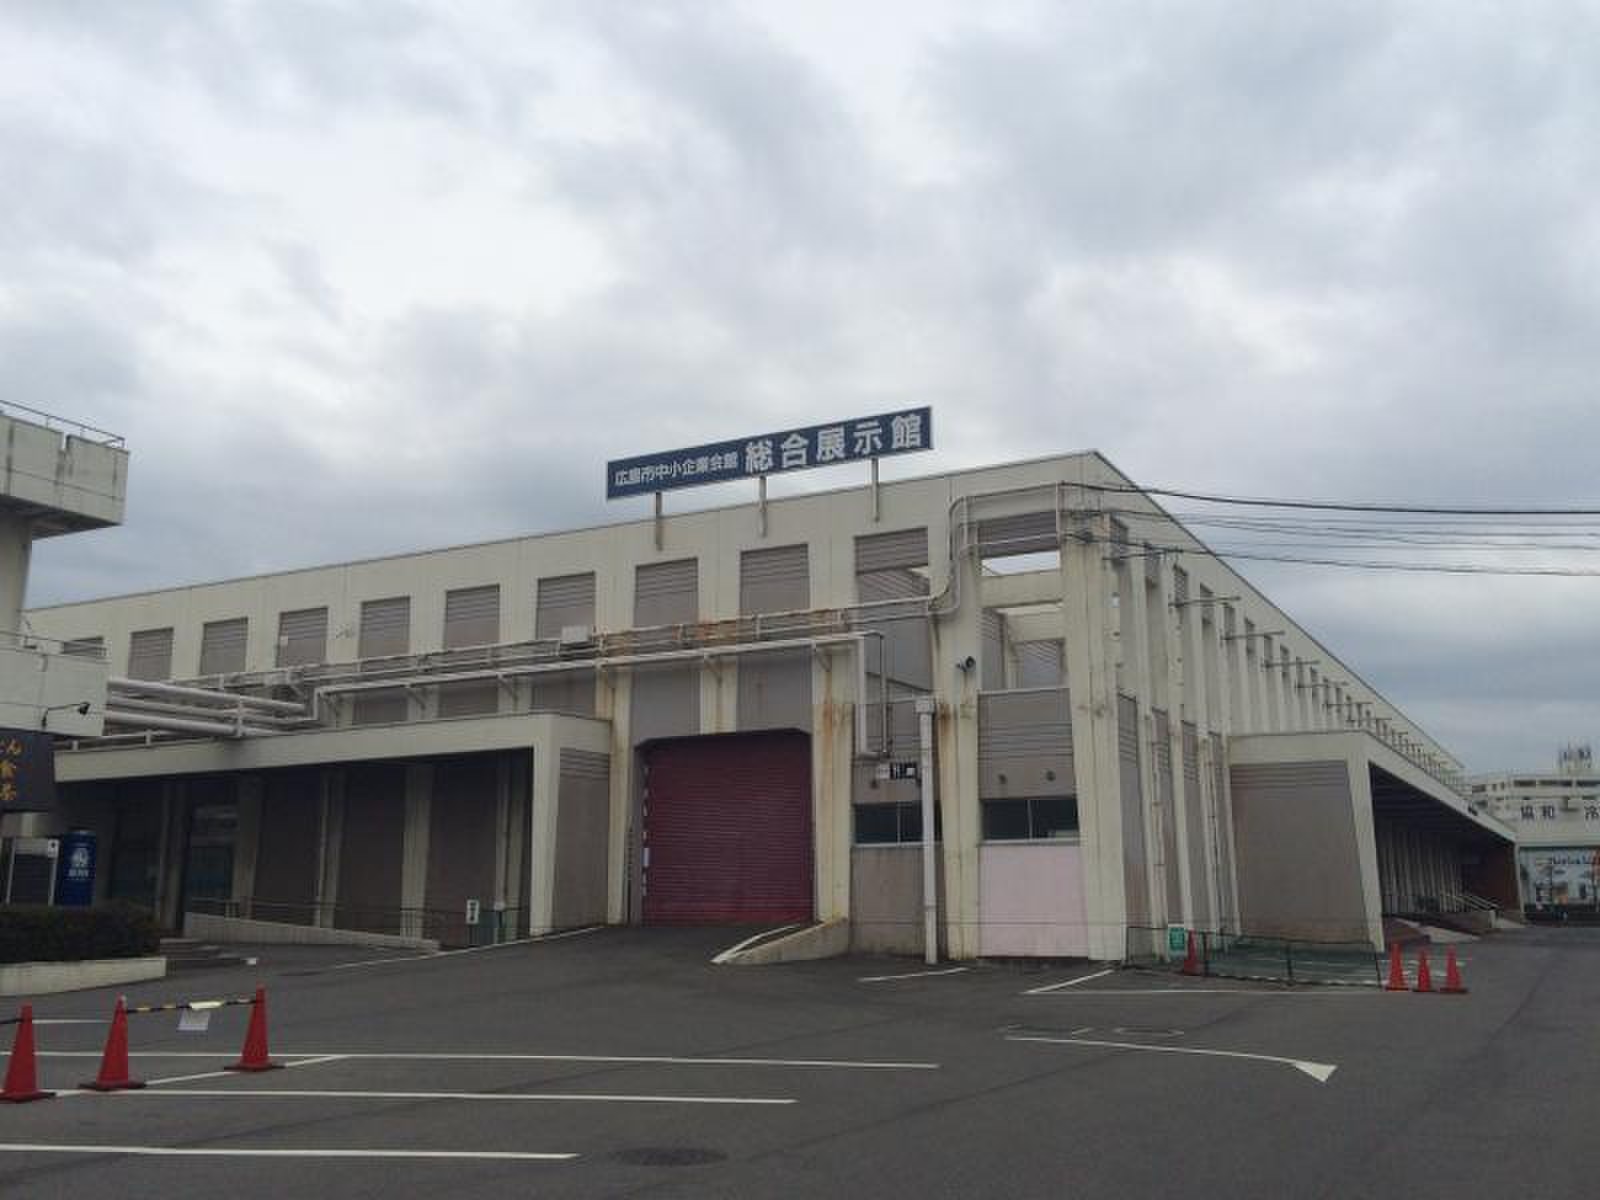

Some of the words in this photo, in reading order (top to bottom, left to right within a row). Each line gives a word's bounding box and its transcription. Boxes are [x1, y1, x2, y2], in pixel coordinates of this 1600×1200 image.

[745, 413, 921, 474] 総合展示館
